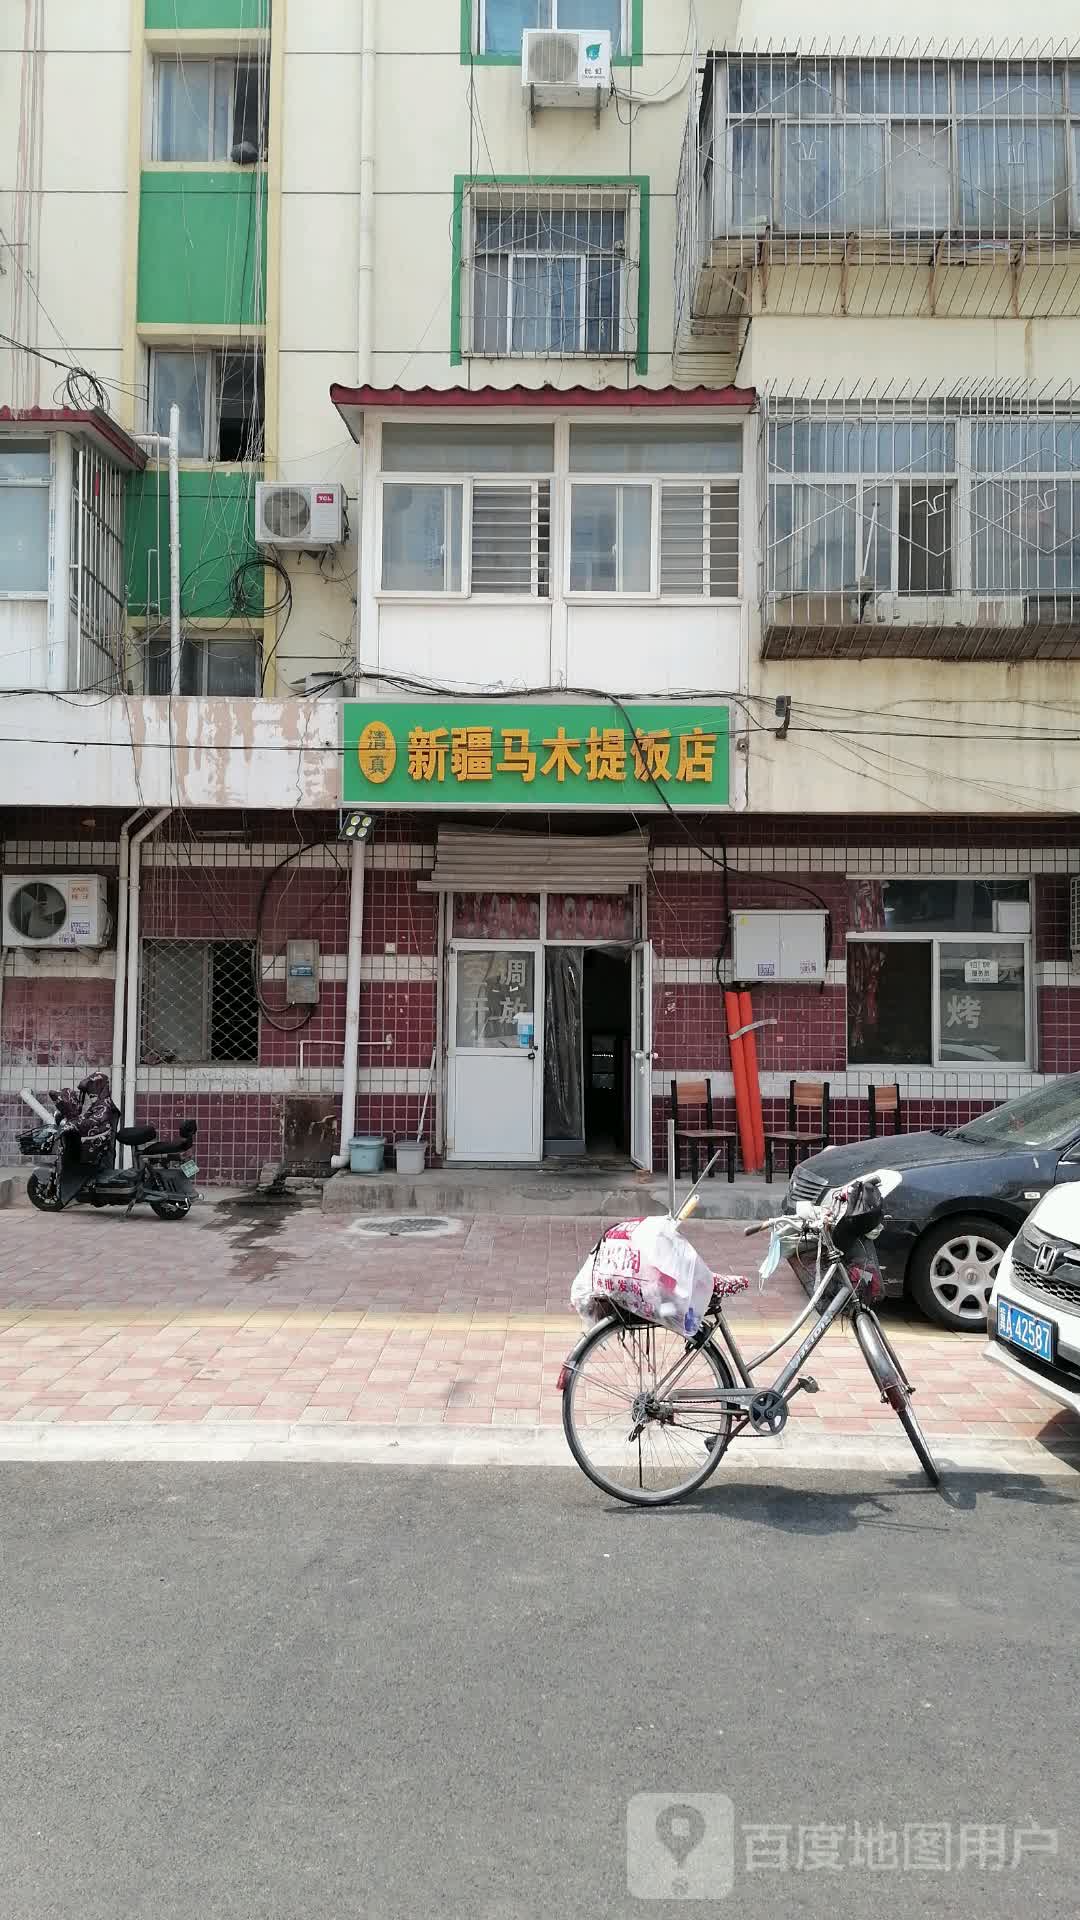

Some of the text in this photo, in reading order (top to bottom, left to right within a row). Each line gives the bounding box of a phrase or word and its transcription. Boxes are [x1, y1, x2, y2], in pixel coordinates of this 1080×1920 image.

[368, 730, 387, 775] 清真
[408, 726, 717, 783] 新疆马木提饭店
[946, 995, 981, 1029] 烤
